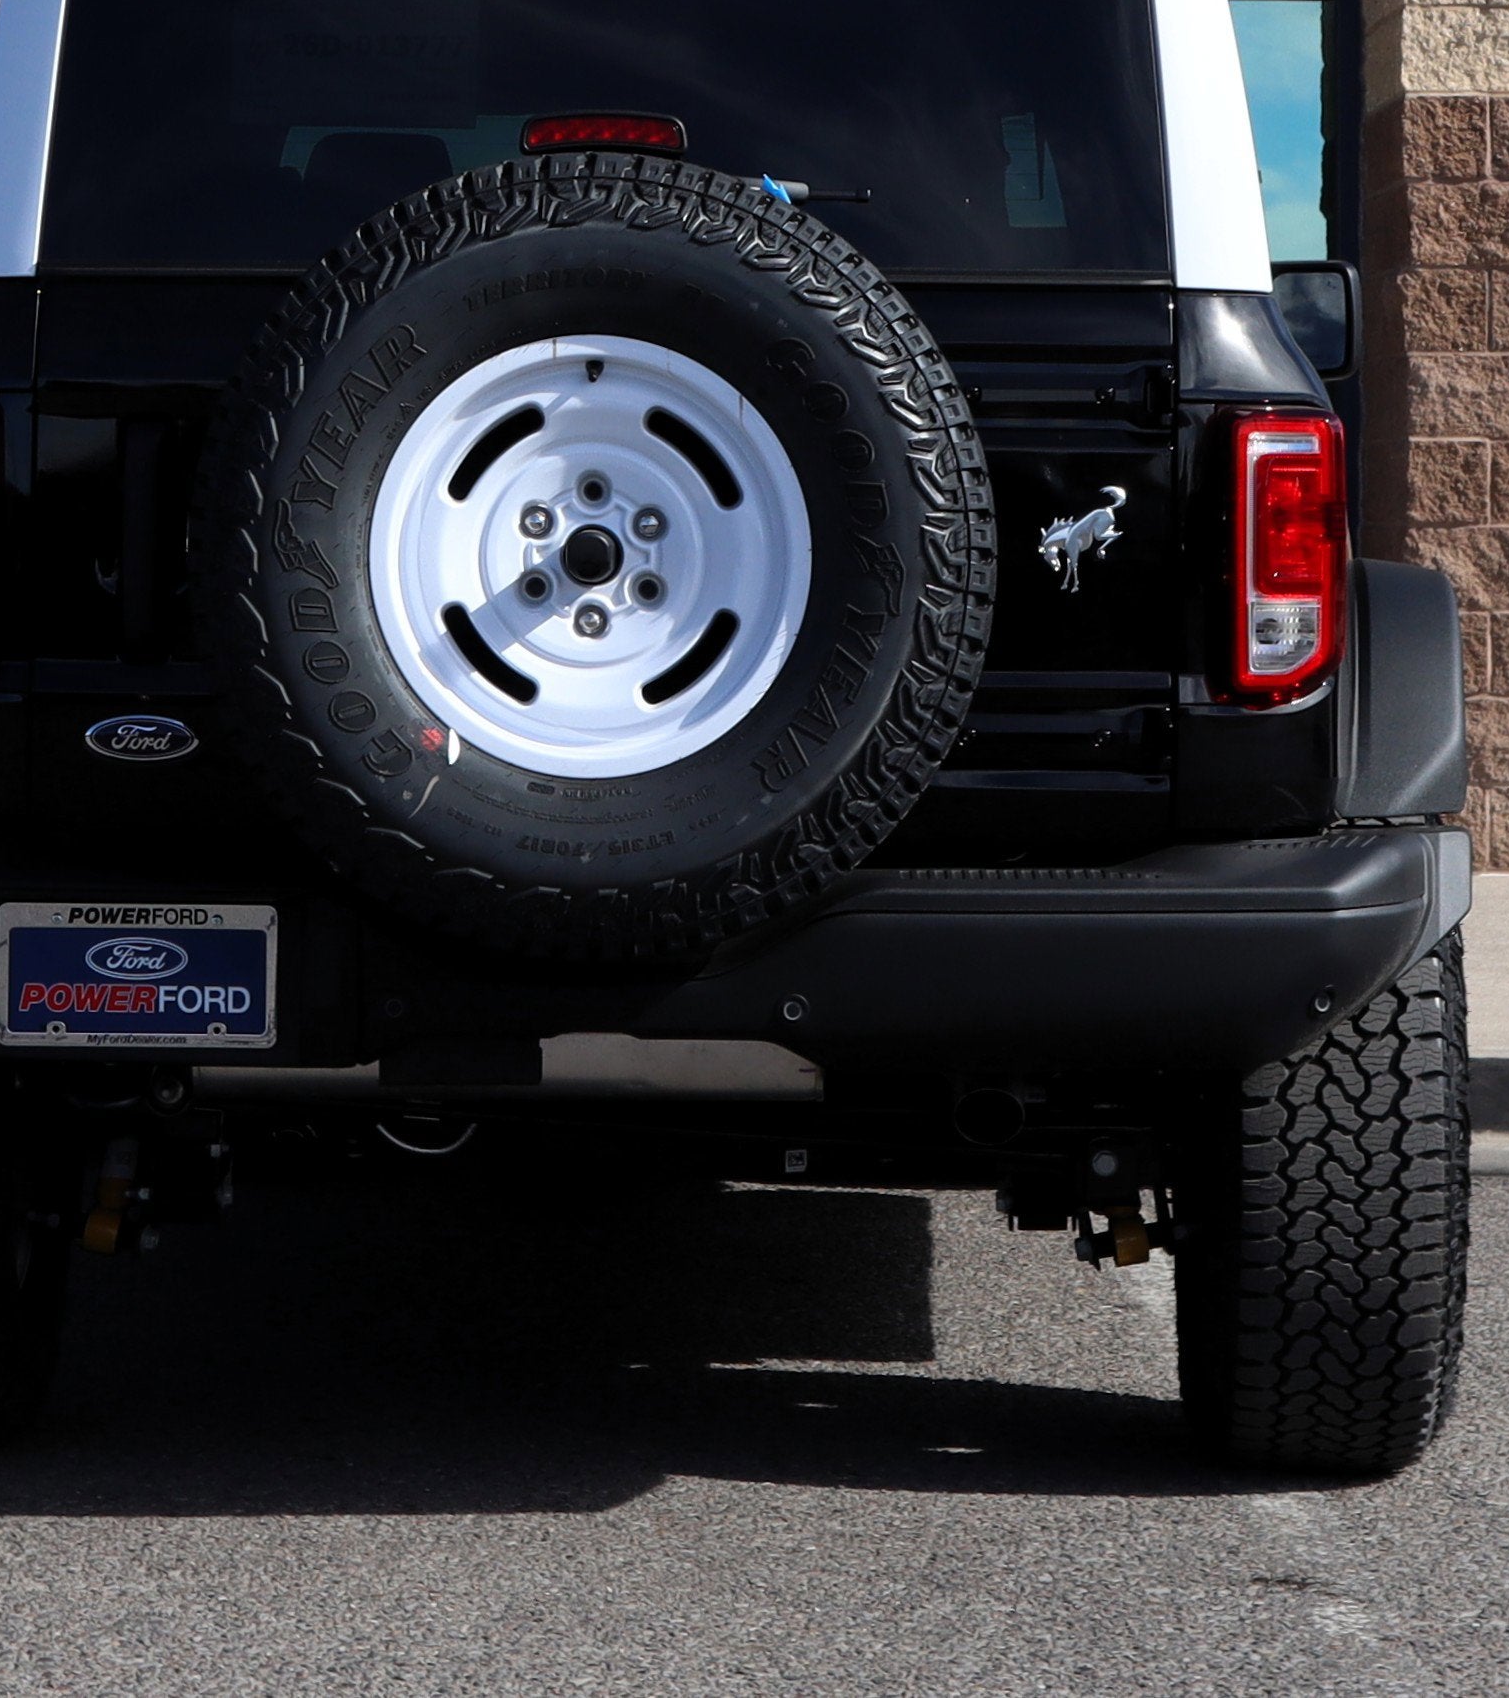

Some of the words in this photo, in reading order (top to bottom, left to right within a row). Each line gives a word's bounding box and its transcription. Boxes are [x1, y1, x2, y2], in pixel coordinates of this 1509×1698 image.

[111, 724, 172, 750] Ford
[68, 907, 209, 926] POWERFORD
[106, 945, 166, 971] Ford
[19, 982, 252, 1015] POWERFORD
